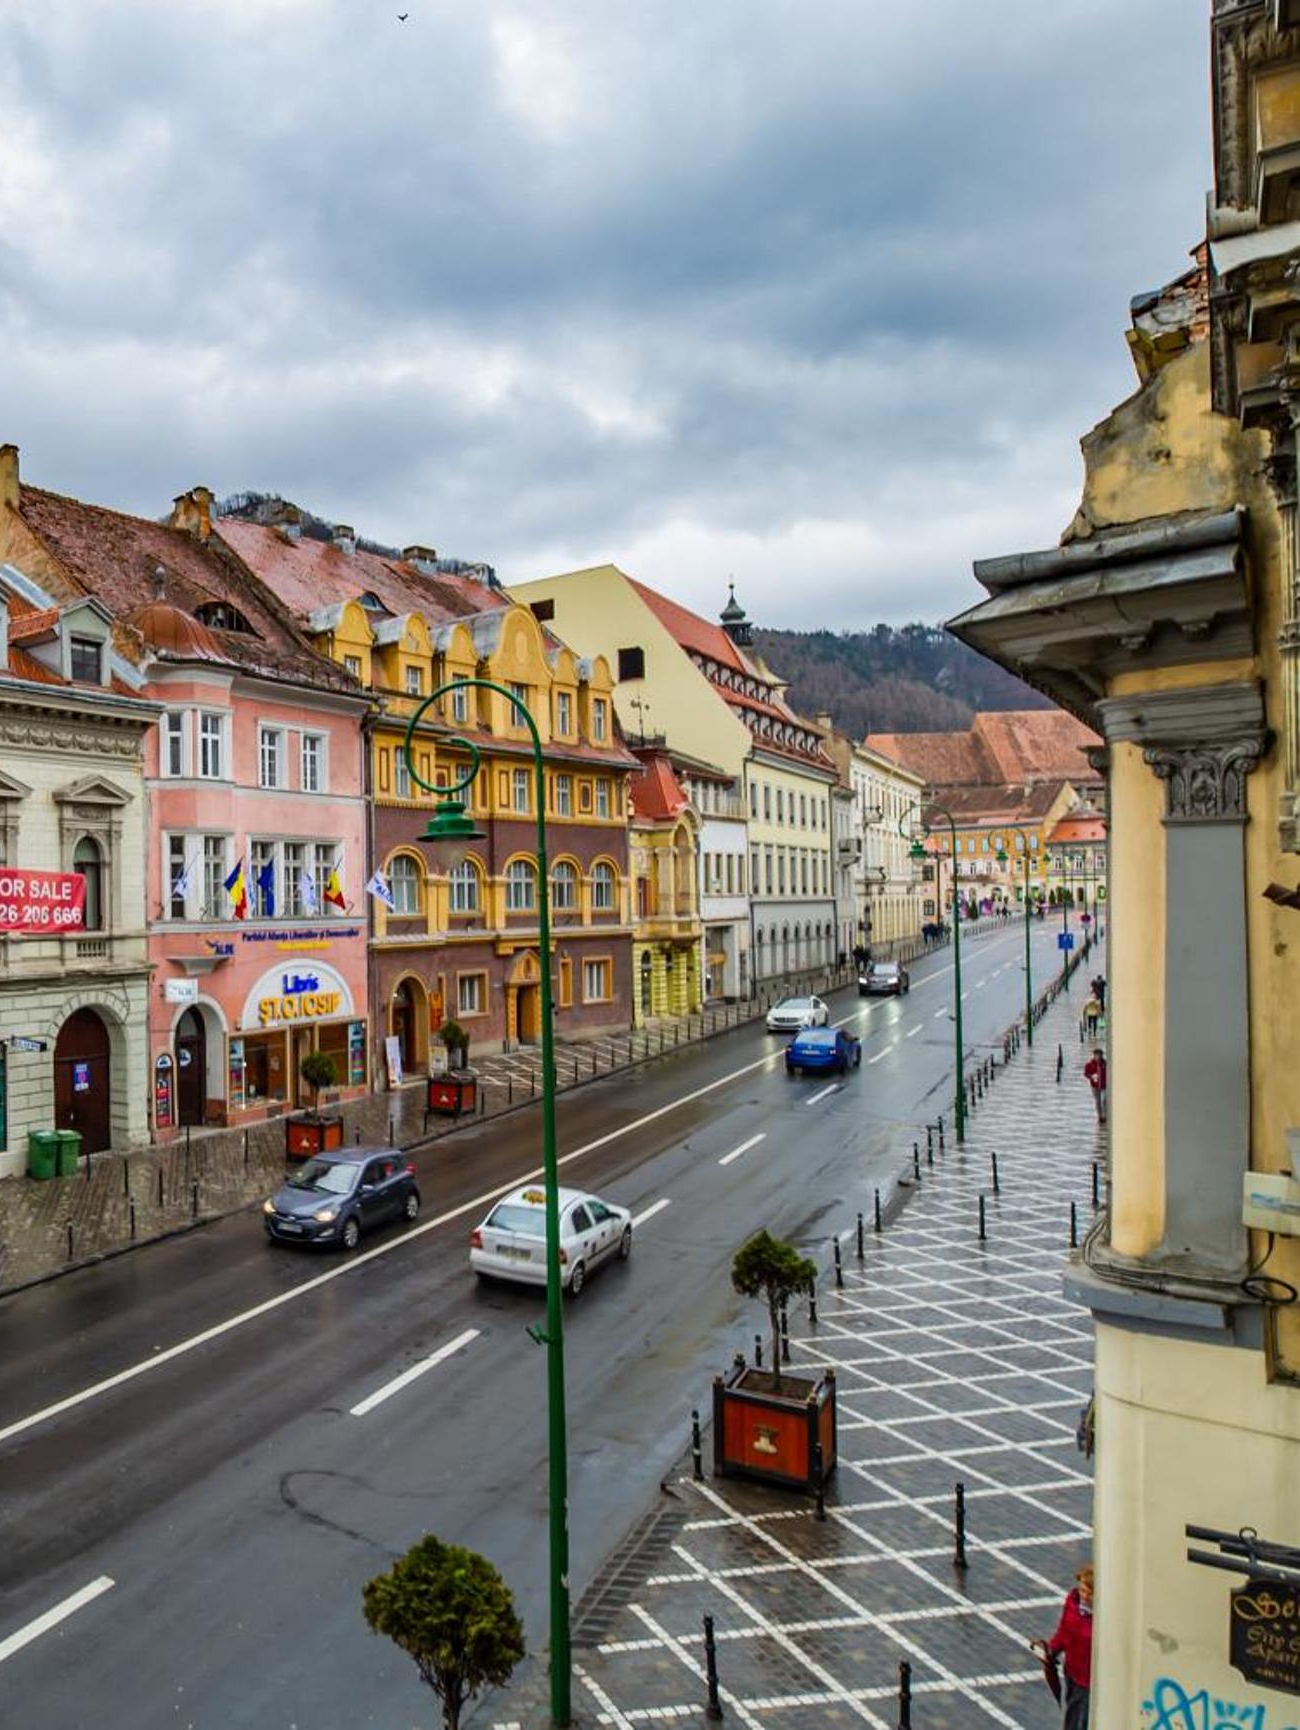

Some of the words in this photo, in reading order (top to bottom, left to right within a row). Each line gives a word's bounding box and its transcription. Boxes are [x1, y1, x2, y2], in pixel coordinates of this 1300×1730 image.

[29, 879, 72, 900] SALE
[21, 905, 49, 925] 206
[52, 906, 82, 925] 666
[282, 973, 319, 994] Libris
